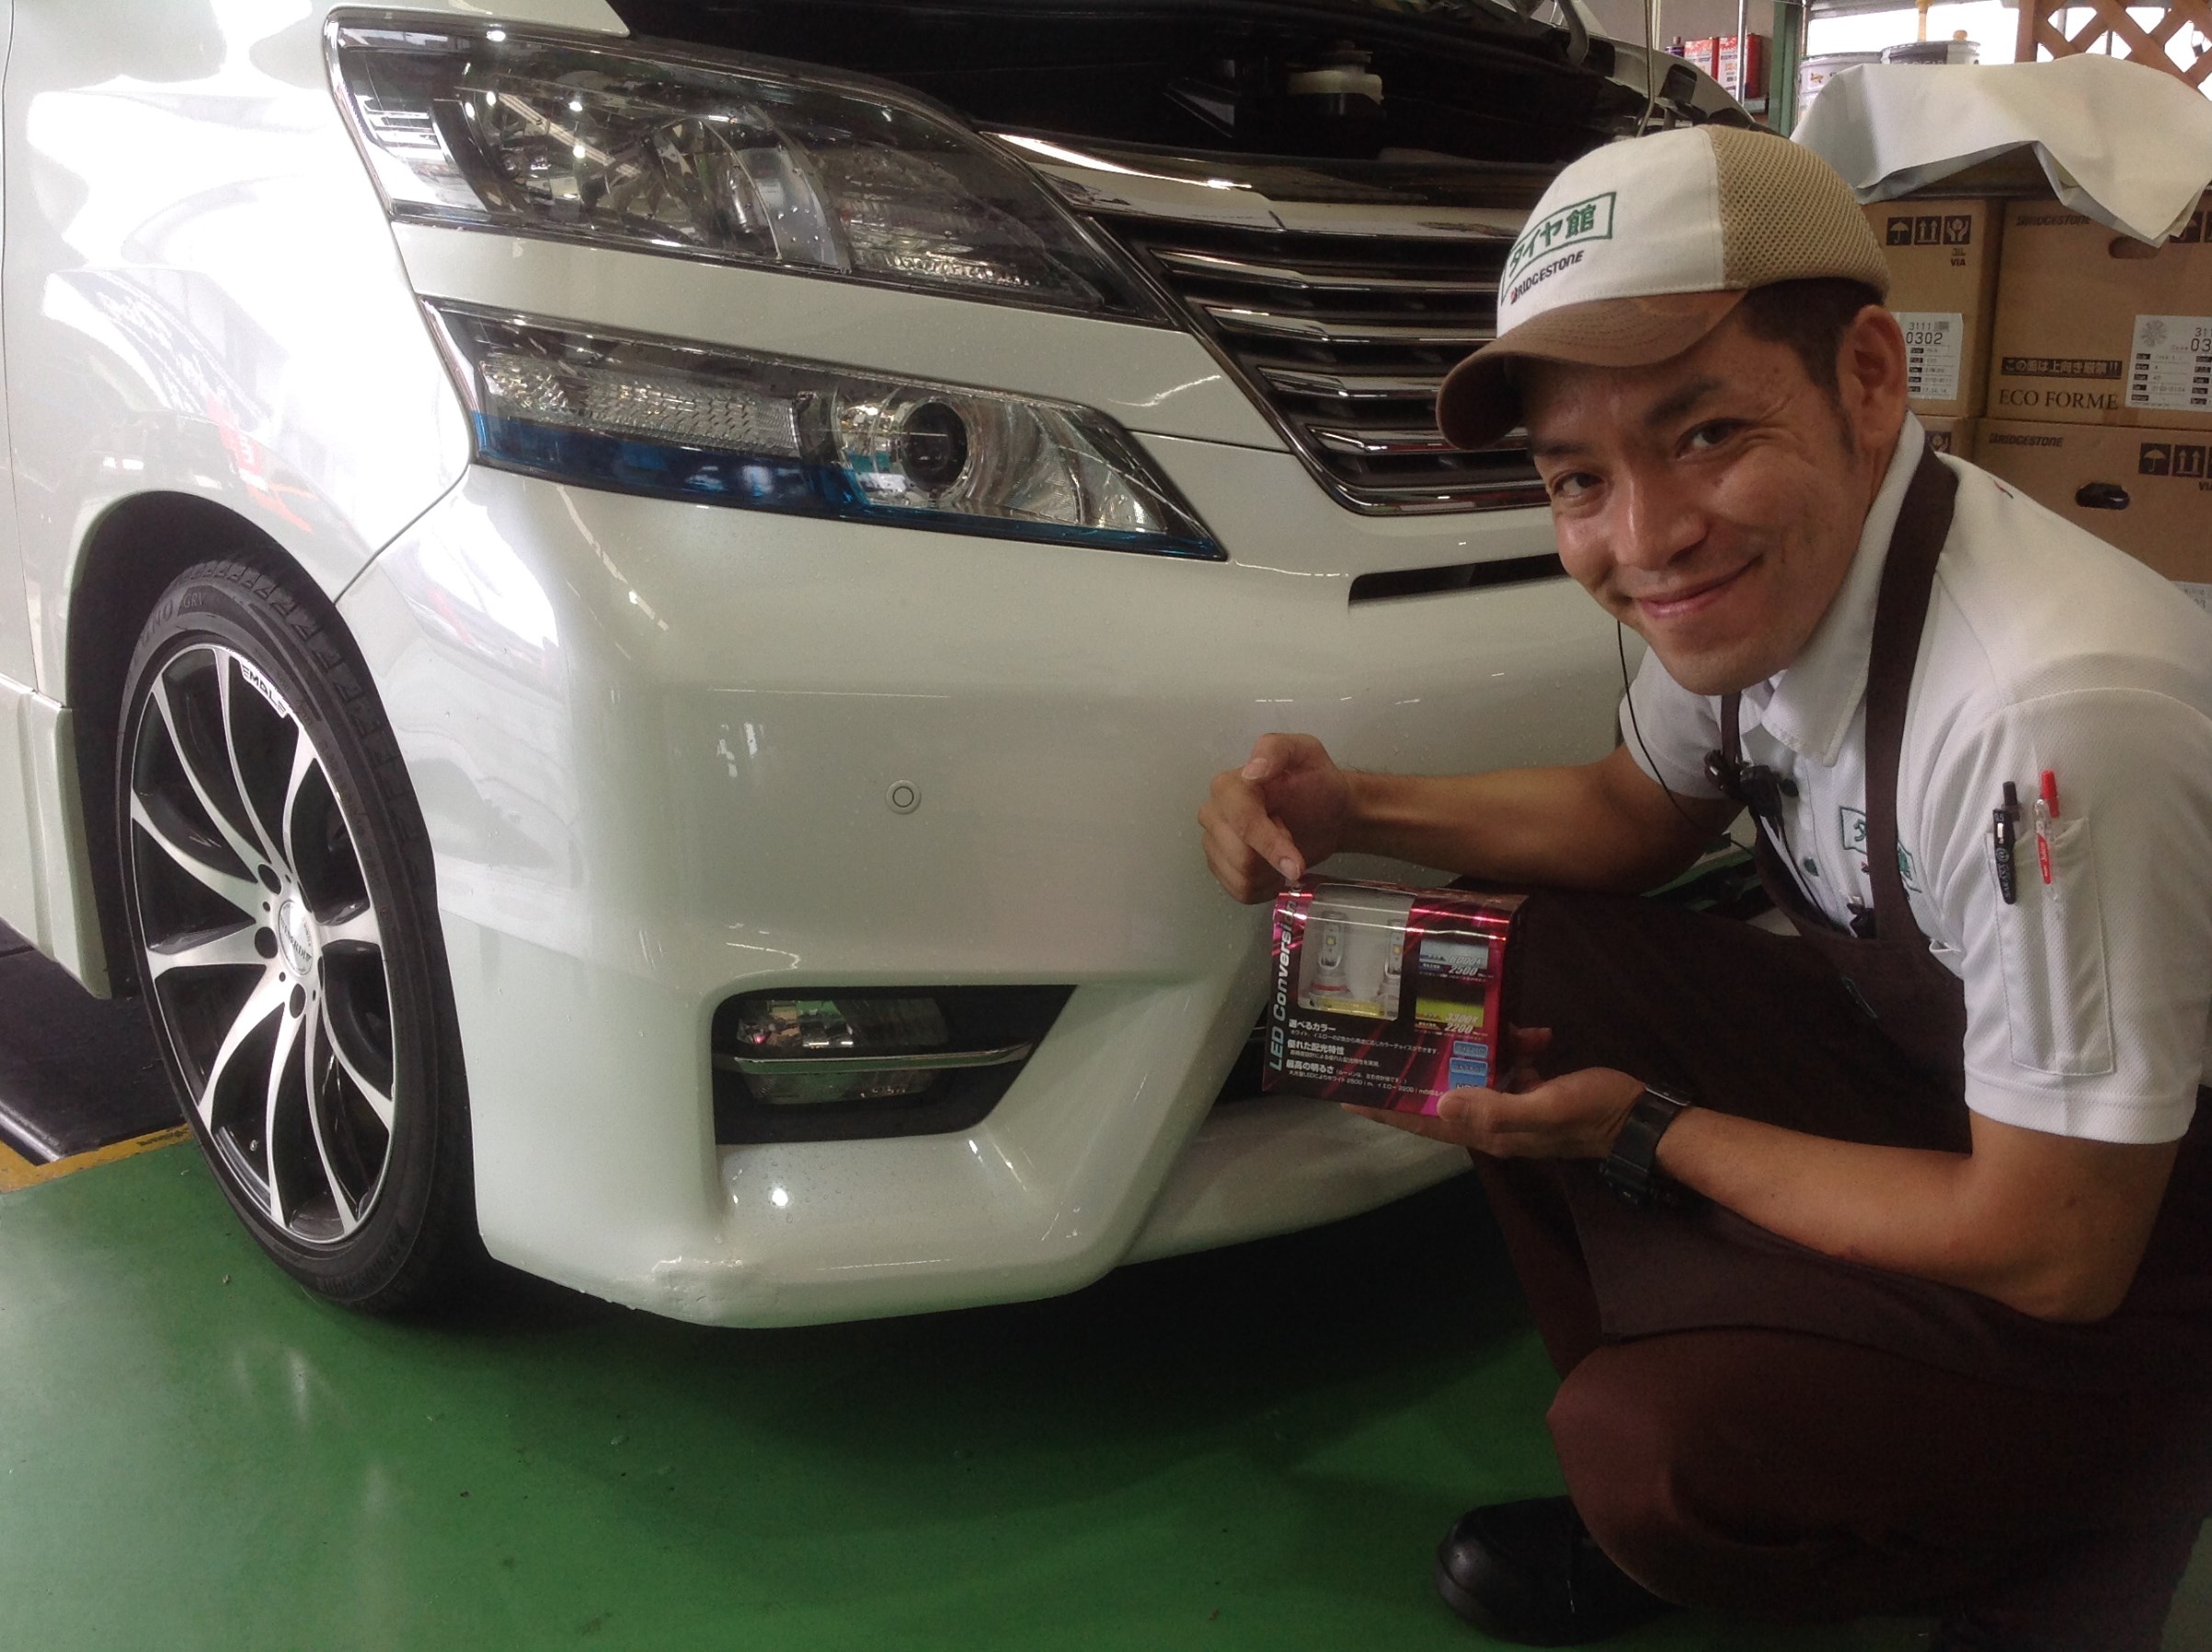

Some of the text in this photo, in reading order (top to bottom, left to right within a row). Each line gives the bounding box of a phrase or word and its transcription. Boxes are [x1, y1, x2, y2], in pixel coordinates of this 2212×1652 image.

[1508, 203, 1597, 278] タイヤ館
[1510, 249, 1585, 304] BRIDGESTONE
[1906, 331, 1943, 345] 0302
[1999, 388, 2040, 407] ECO
[2044, 390, 2120, 411] FORME
[1989, 432, 2064, 447] BRIDGESTONE
[1448, 965, 1478, 977] 2500
[1289, 1018, 1337, 1032] 選べるカラー
[1444, 1022, 1473, 1035] 2200
[1269, 1027, 1285, 1073] LED
